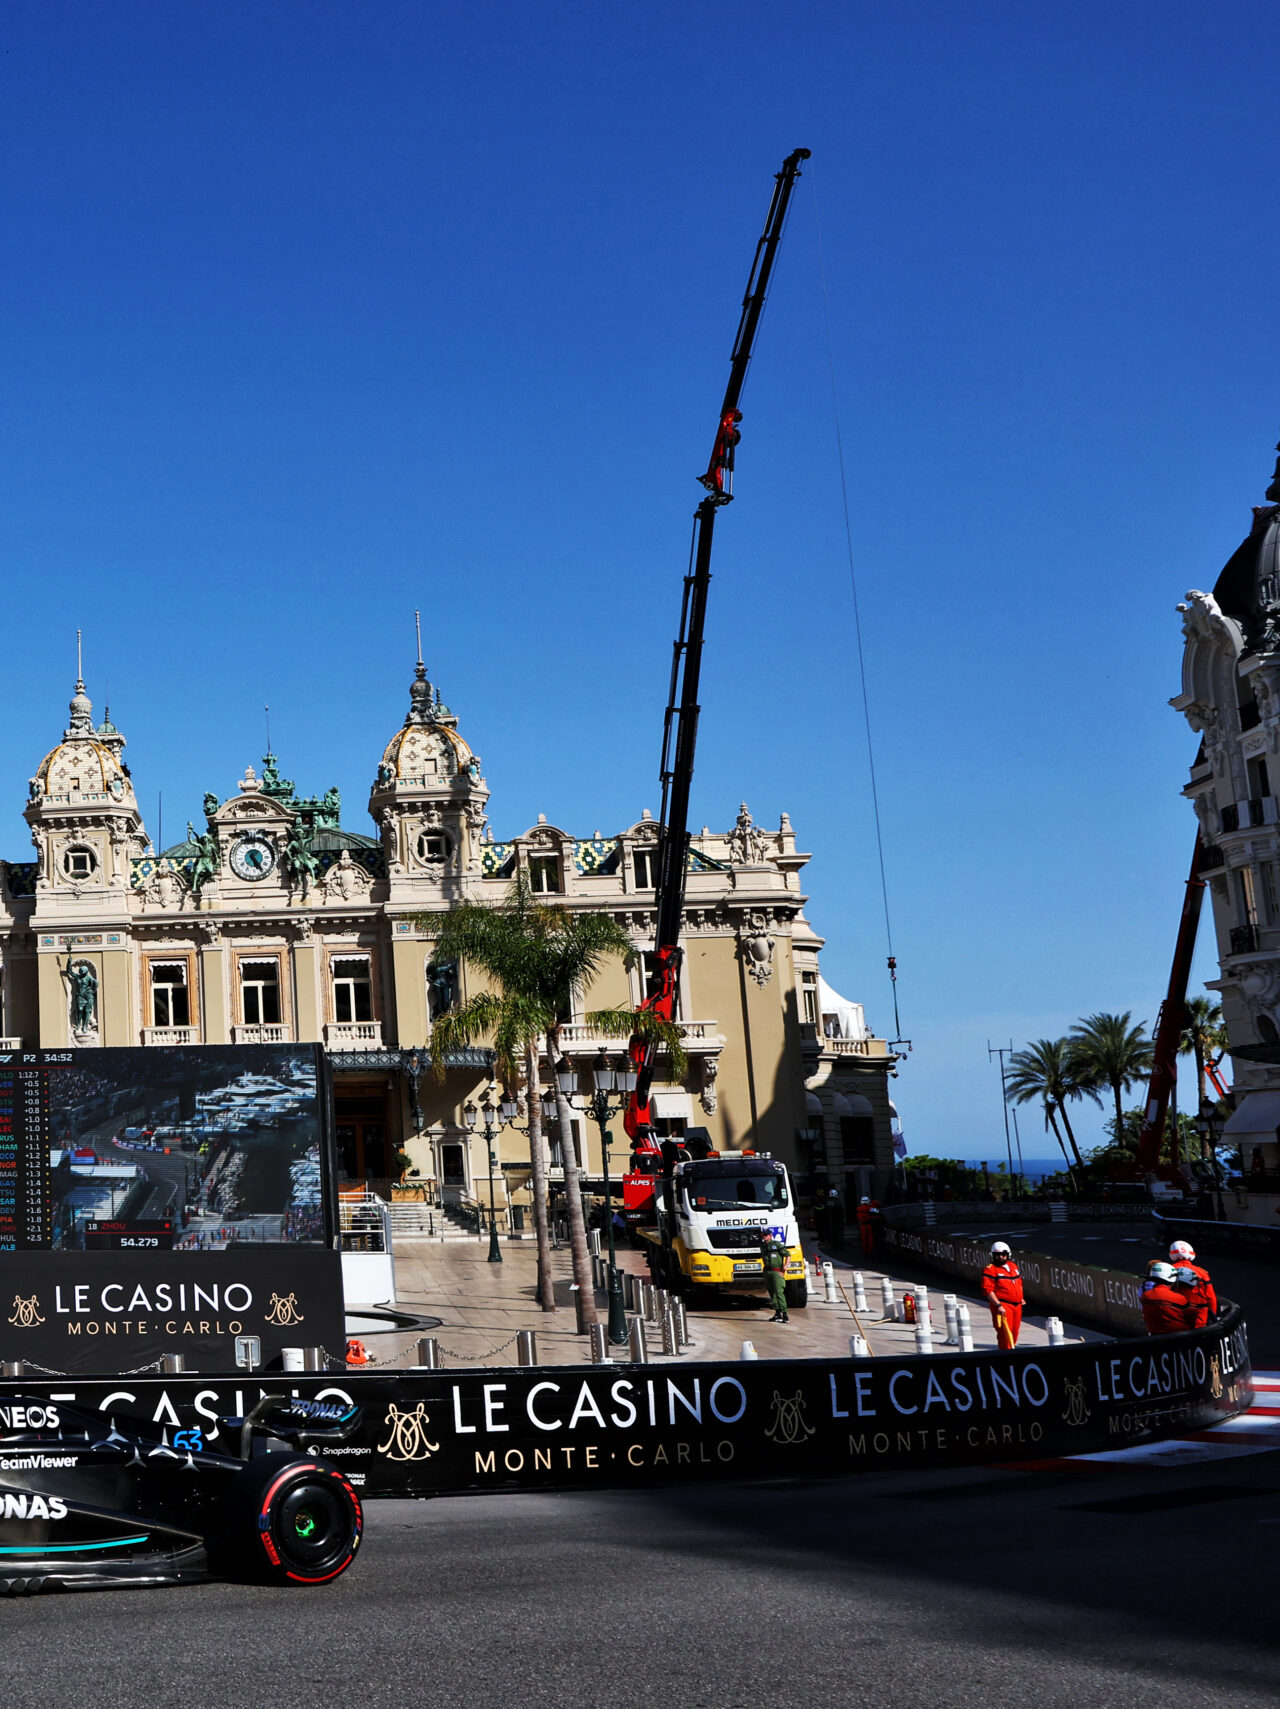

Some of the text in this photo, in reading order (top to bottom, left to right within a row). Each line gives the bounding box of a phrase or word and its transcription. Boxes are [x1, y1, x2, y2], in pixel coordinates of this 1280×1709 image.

[23, 1054, 37, 1062] P2
[43, 1053, 73, 1062] 34:52
[120, 1238, 159, 1247] 54.279
[1051, 1266, 1094, 1297] LE CASINO
[1104, 1279, 1115, 1303] LE
[55, 1283, 253, 1312] LE CASINO
[1220, 1336, 1233, 1375] LE
[1095, 1347, 1206, 1401] LE CASINO
[453, 1376, 747, 1433] LE CASINO
[829, 1363, 1049, 1418] LE CASINO
[174, 1430, 203, 1451] 63
[321, 1446, 371, 1456] Snapdragon
